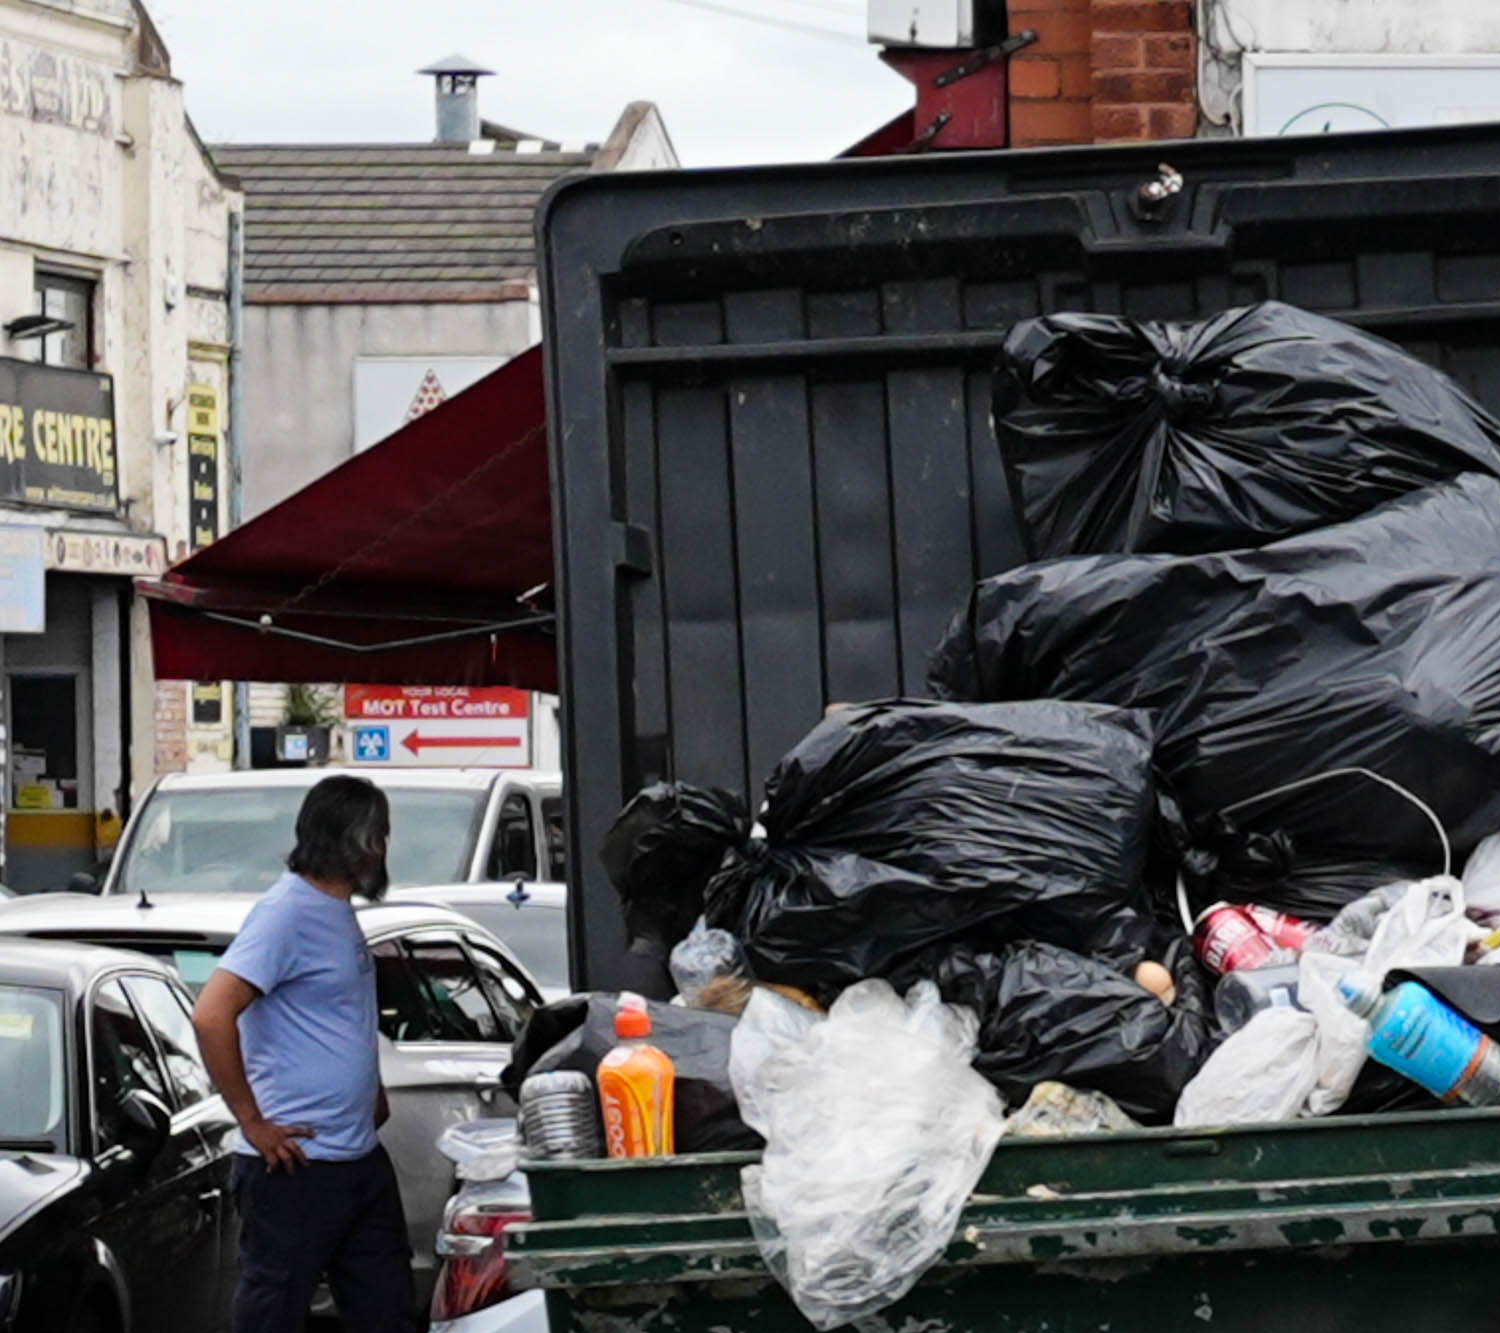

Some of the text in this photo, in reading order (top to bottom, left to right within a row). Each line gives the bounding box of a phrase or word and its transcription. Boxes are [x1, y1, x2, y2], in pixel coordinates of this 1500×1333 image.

[32, 409, 114, 474] CENTRE
[363, 699, 510, 715] MOT Test Centre
